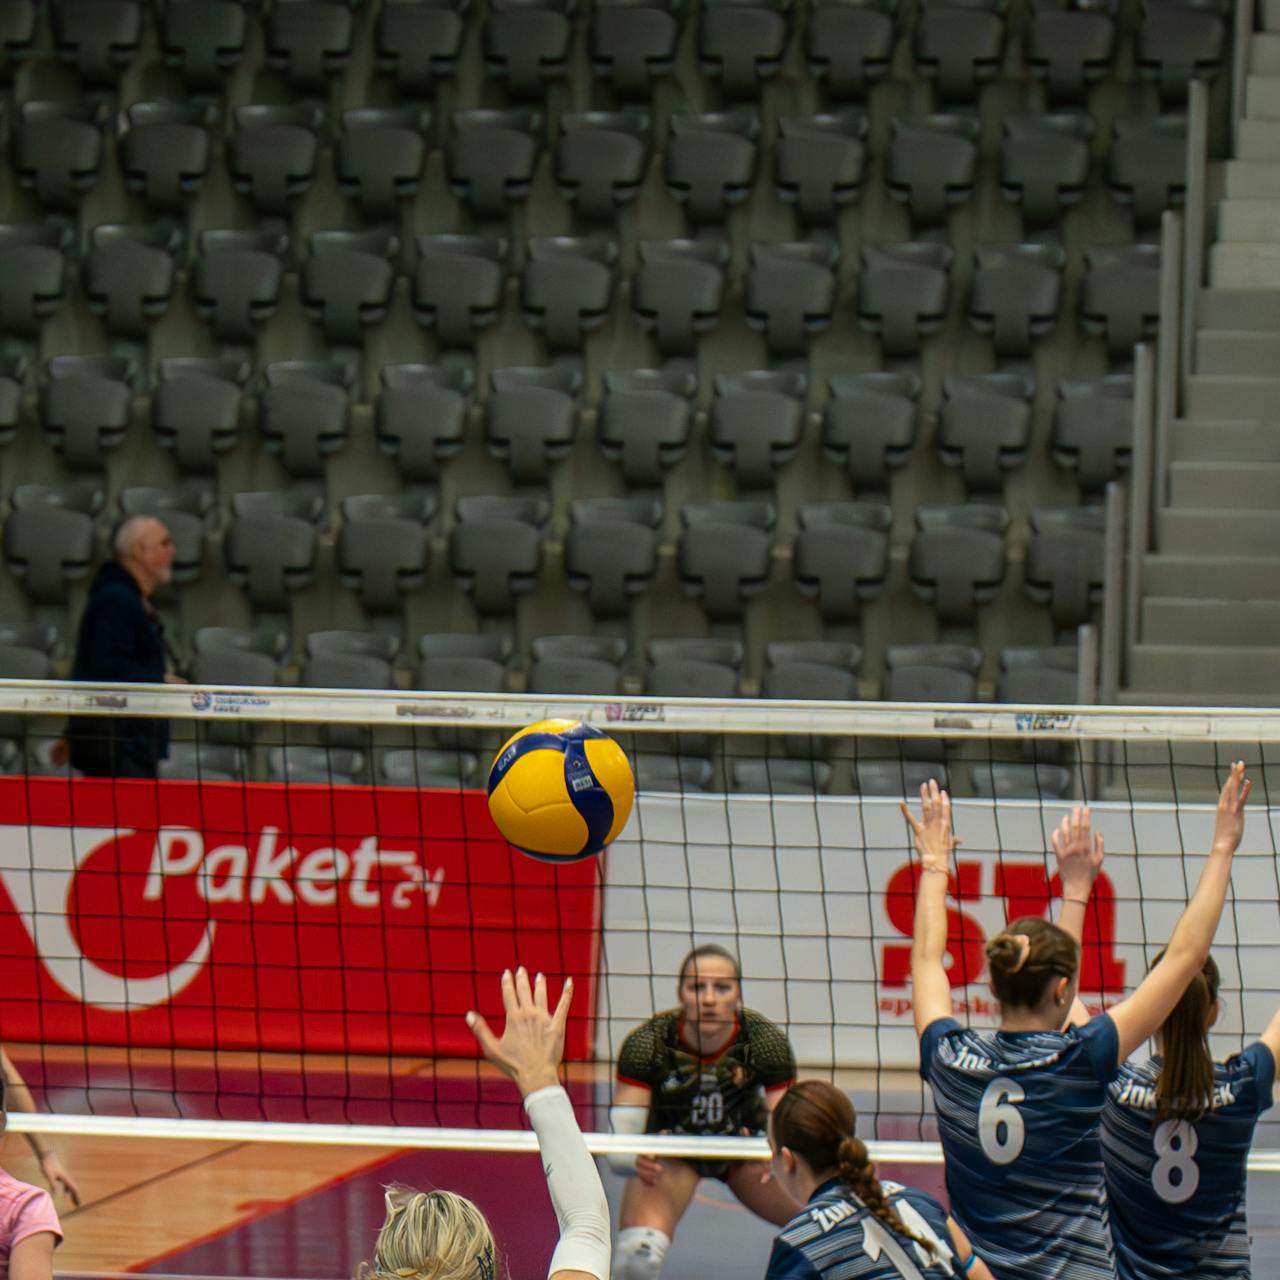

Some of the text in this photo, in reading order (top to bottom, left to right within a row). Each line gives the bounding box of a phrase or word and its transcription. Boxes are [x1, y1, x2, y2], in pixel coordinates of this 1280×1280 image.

[690, 1091, 724, 1125] 20
[978, 1077, 1025, 1166] 6
[1151, 1119, 1200, 1204] 8
